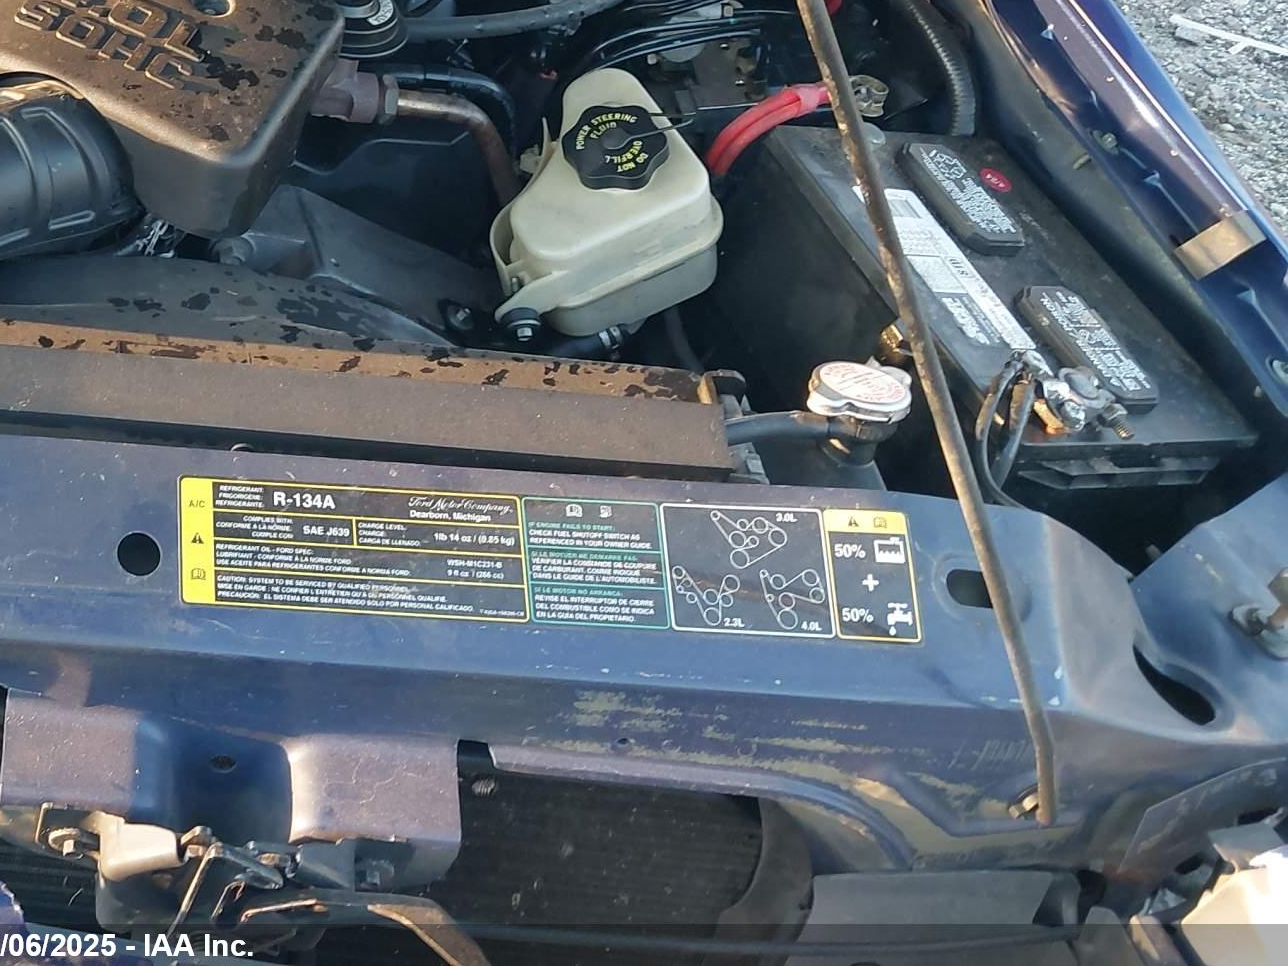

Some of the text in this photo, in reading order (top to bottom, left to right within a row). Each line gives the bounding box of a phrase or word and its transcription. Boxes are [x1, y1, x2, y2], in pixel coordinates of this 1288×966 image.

[576, 113, 638, 150] POWER STEERING
[590, 122, 617, 139] FLUID
[604, 140, 643, 163] OVERFILL
[616, 153, 648, 172] DO NOT
[188, 499, 205, 507] A/C
[272, 490, 335, 509] R-134A
[407, 495, 432, 510] Ford
[431, 497, 463, 512] Motor
[243, 515, 275, 523] COMPLIES
[409, 509, 491, 522] Dearborn, Michigan
[776, 513, 798, 522] 3.0L
[215, 520, 251, 529] CONFORME
[358, 521, 384, 529] CHARGE
[302, 525, 349, 537] SAE J639
[528, 528, 552, 536] CHECK
[553, 529, 571, 537] FUEL
[571, 530, 604, 539] SHUTOFF
[603, 532, 630, 540] SWITCH
[449, 533, 459, 542] 14
[460, 533, 471, 543] oz
[499, 536, 514, 545] kg)
[529, 536, 575, 545] REFERENCED
[584, 539, 603, 547] YOUR
[603, 540, 629, 548] OWNER
[215, 543, 259, 551] REFRIGERANT
[834, 544, 866, 558] 50%
[216, 551, 252, 559] LUBRIFIANT
[257, 553, 292, 561] CONFORME
[271, 562, 324, 571] REFRIGERANTES
[325, 565, 359, 573] CONFORME
[573, 559, 612, 567] COMMANDE
[623, 562, 656, 570] COUPURE
[447, 569, 452, 577] 9
[492, 572, 504, 580] cc)
[532, 571, 551, 579] DANS
[562, 573, 584, 581] GUIDE
[586, 567, 612, 575] COMME
[248, 577, 274, 585] SYSTEM
[294, 579, 326, 587] SERVICED
[336, 582, 370, 590] QUALIFIED
[244, 584, 266, 592] GARDE
[281, 586, 308, 594] CONFIER
[378, 592, 416, 600] PERSONNEL
[273, 593, 301, 601] SISTEMA
[334, 597, 365, 605] ATENDIDO
[400, 601, 433, 609] PERSONAL
[534, 593, 558, 601] REVISE
[569, 595, 616, 605] INTERRUPTOR
[628, 599, 654, 607] CIERRE
[535, 601, 550, 609] DEL
[550, 602, 598, 612] COMBUSTIBLE
[598, 605, 620, 613] COMO
[631, 607, 654, 615] INDICA
[842, 608, 874, 623] 50%
[724, 618, 744, 628] 2.3L
[801, 621, 822, 631] 4.0L
